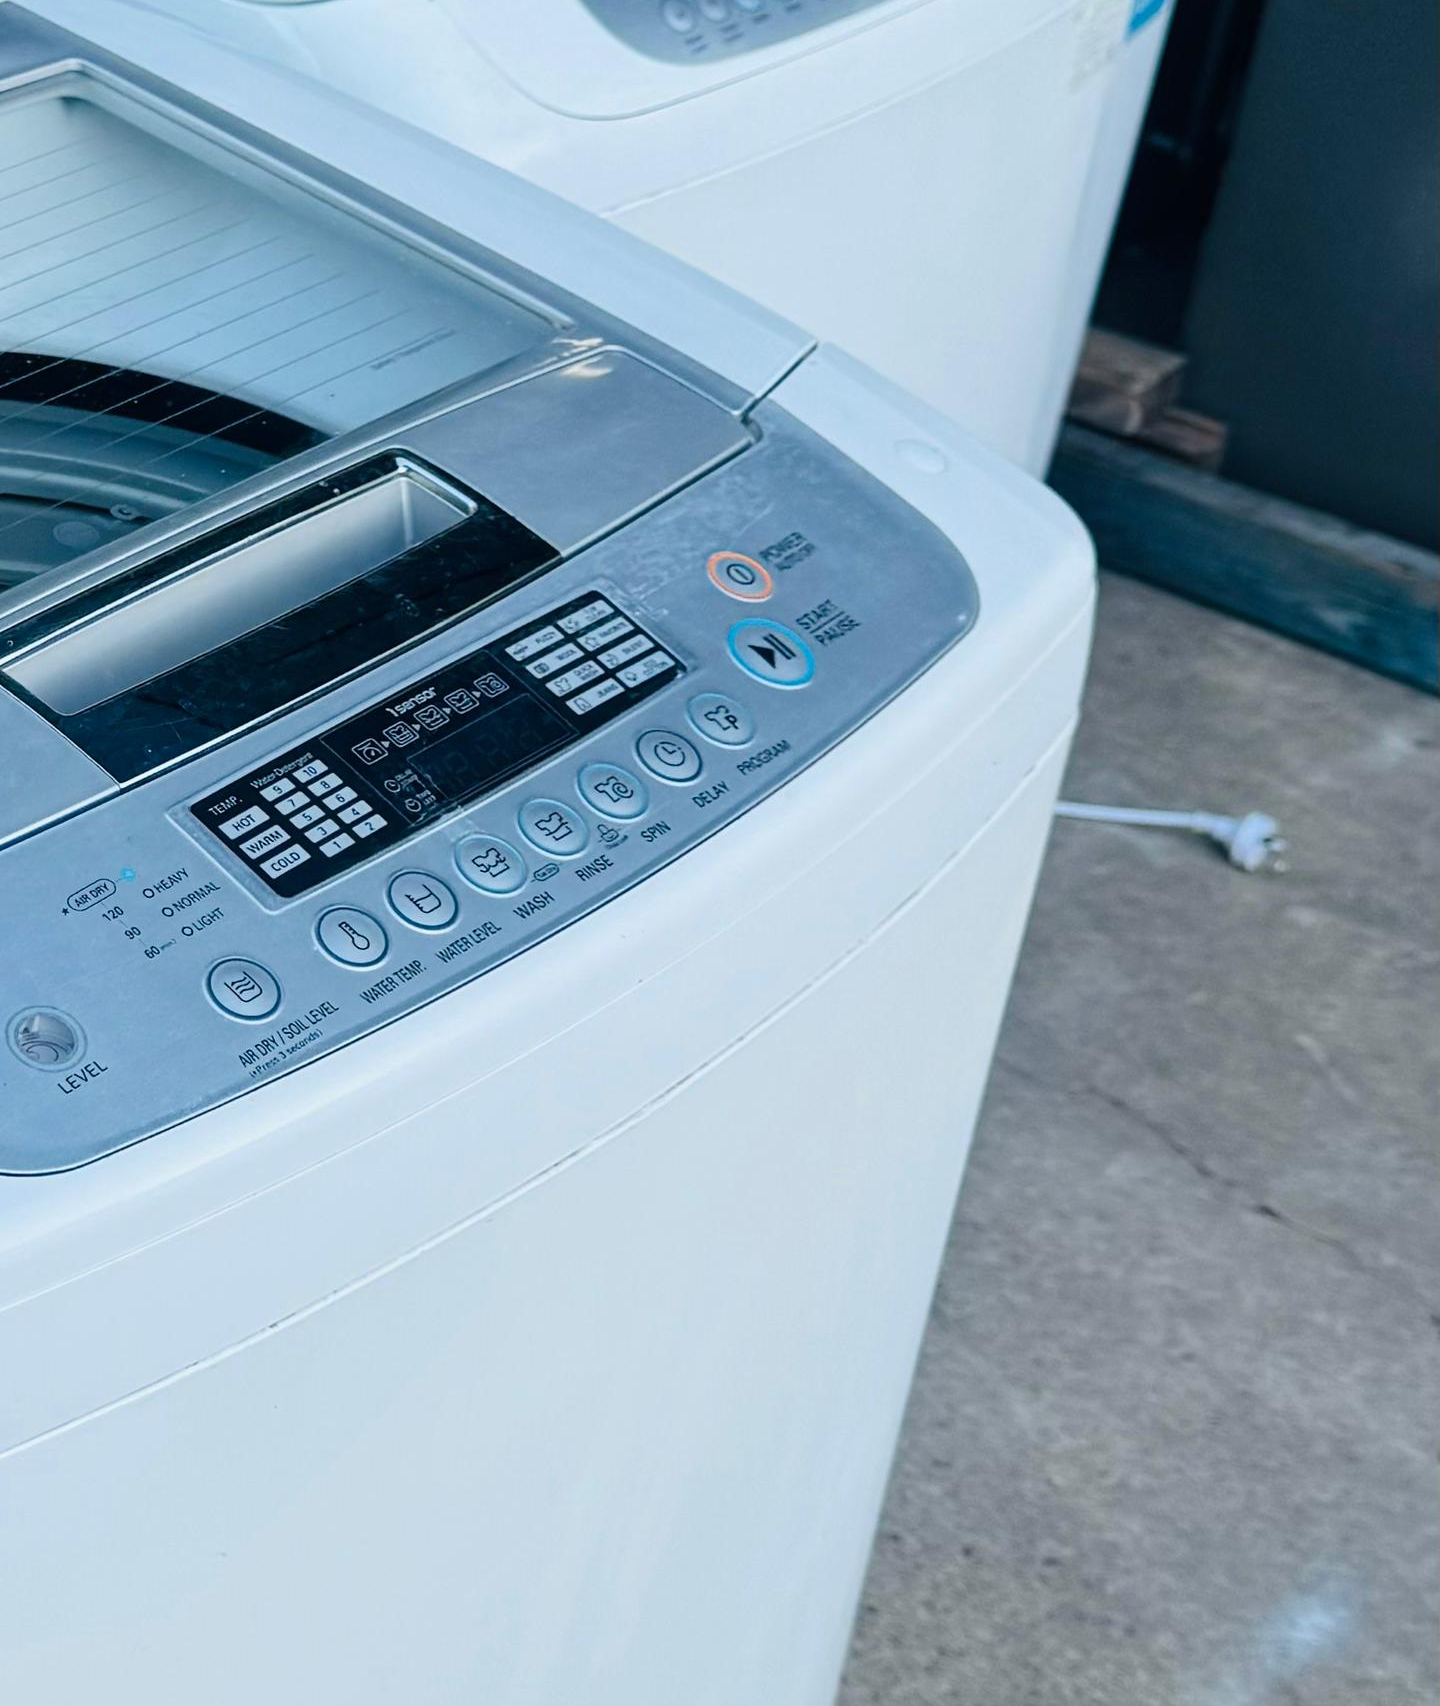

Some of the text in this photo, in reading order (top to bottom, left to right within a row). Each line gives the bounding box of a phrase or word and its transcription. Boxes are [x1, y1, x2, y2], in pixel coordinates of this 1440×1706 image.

[796, 599, 836, 630] START
[736, 739, 791, 775] PROGRAM
[305, 766, 317, 776] 10
[321, 781, 330, 790] 8
[691, 780, 730, 808] DELAY
[208, 796, 243, 817] TEMP.
[288, 799, 296, 808] 7
[336, 794, 345, 804] 6
[233, 814, 257, 832] HOT
[303, 813, 312, 822] 5
[351, 808, 360, 817] 4
[318, 827, 328, 836] 3
[365, 822, 374, 831] 2
[641, 820, 672, 843] SPIN
[246, 830, 283, 854] WARM
[335, 840, 342, 849] 1
[271, 852, 300, 872] COLD
[575, 854, 614, 882] RINSE
[153, 867, 189, 895] HEAVY
[74, 883, 110, 908] AIR DRY
[172, 881, 222, 912] NORMAL
[513, 891, 555, 919] WASH
[102, 906, 124, 922] 120
[192, 907, 225, 932] LIGHT
[124, 926, 141, 940] 90
[436, 920, 502, 964] WATER LEVEL
[144, 945, 160, 960] 60
[359, 959, 427, 1004] WATER TEMP.
[238, 1049, 259, 1068] AIR
[259, 1037, 278, 1056] DRY
[282, 1016, 309, 1040] SOIL
[305, 1001, 340, 1025] LEVEL
[57, 1059, 109, 1095] LEVEL
